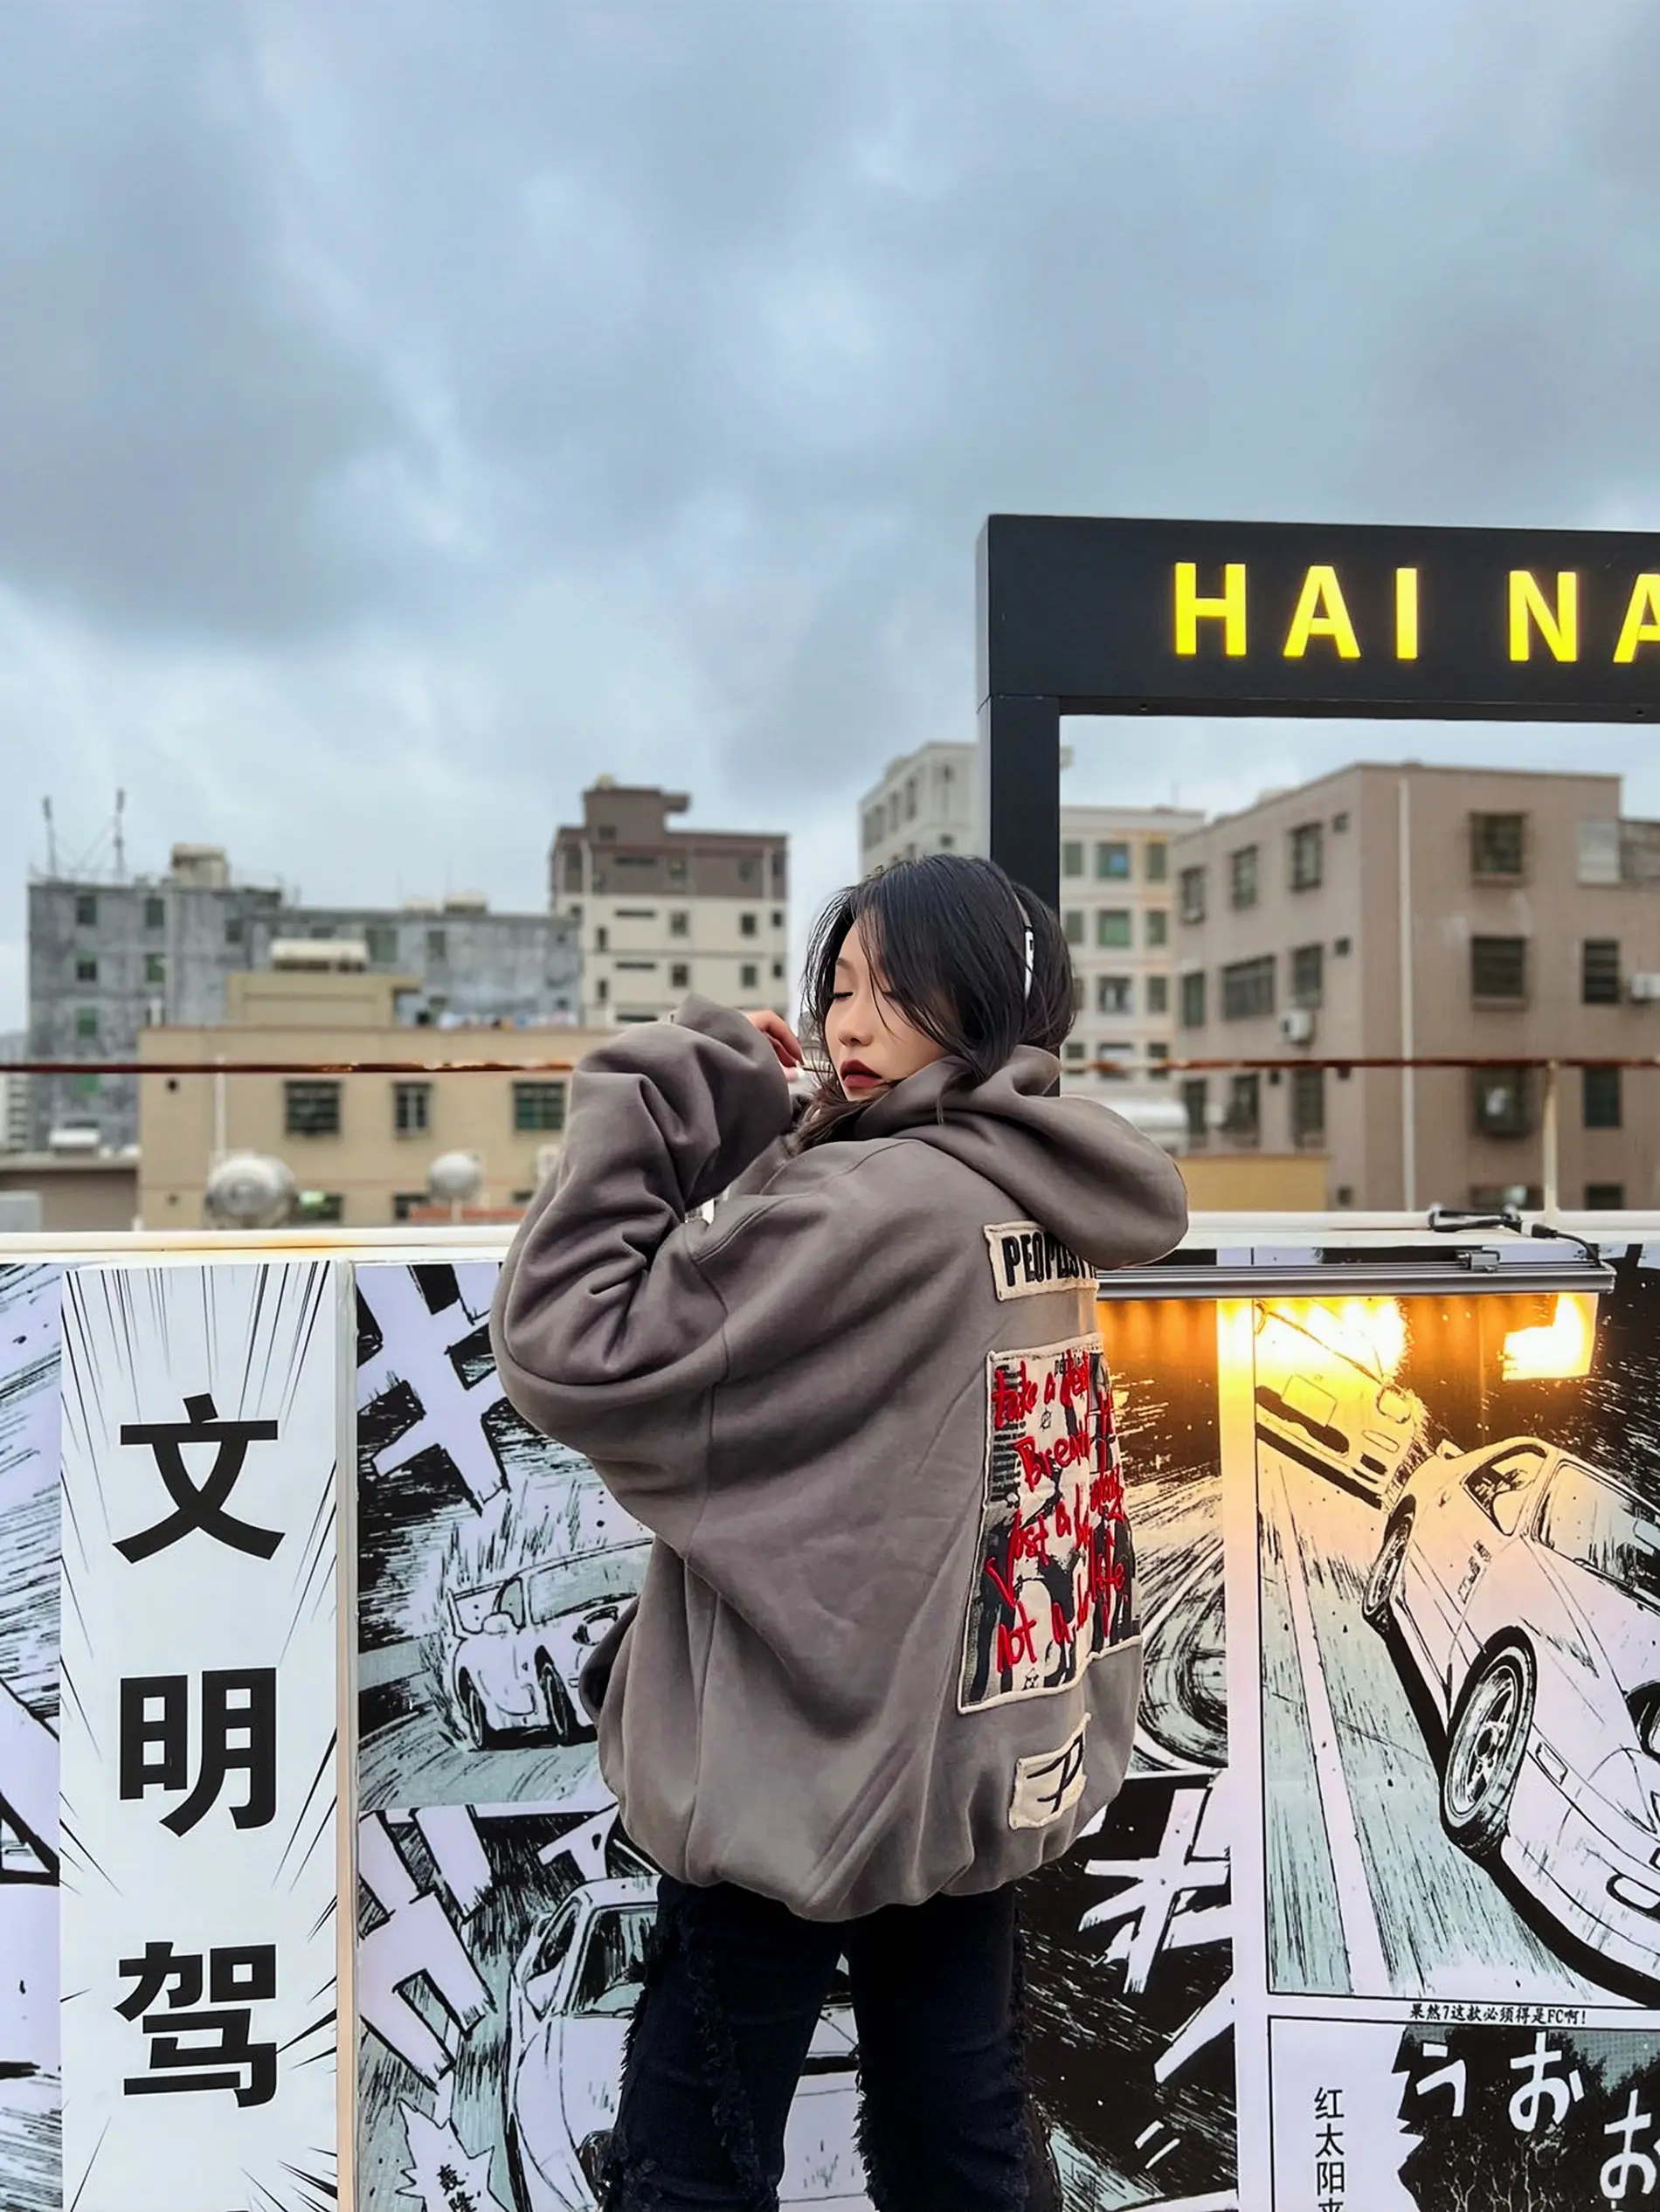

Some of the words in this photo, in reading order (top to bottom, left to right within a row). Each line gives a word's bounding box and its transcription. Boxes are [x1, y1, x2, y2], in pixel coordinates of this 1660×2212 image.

[1174, 563, 1419, 660] HAI
[113, 1393, 285, 2107] 文明驾
